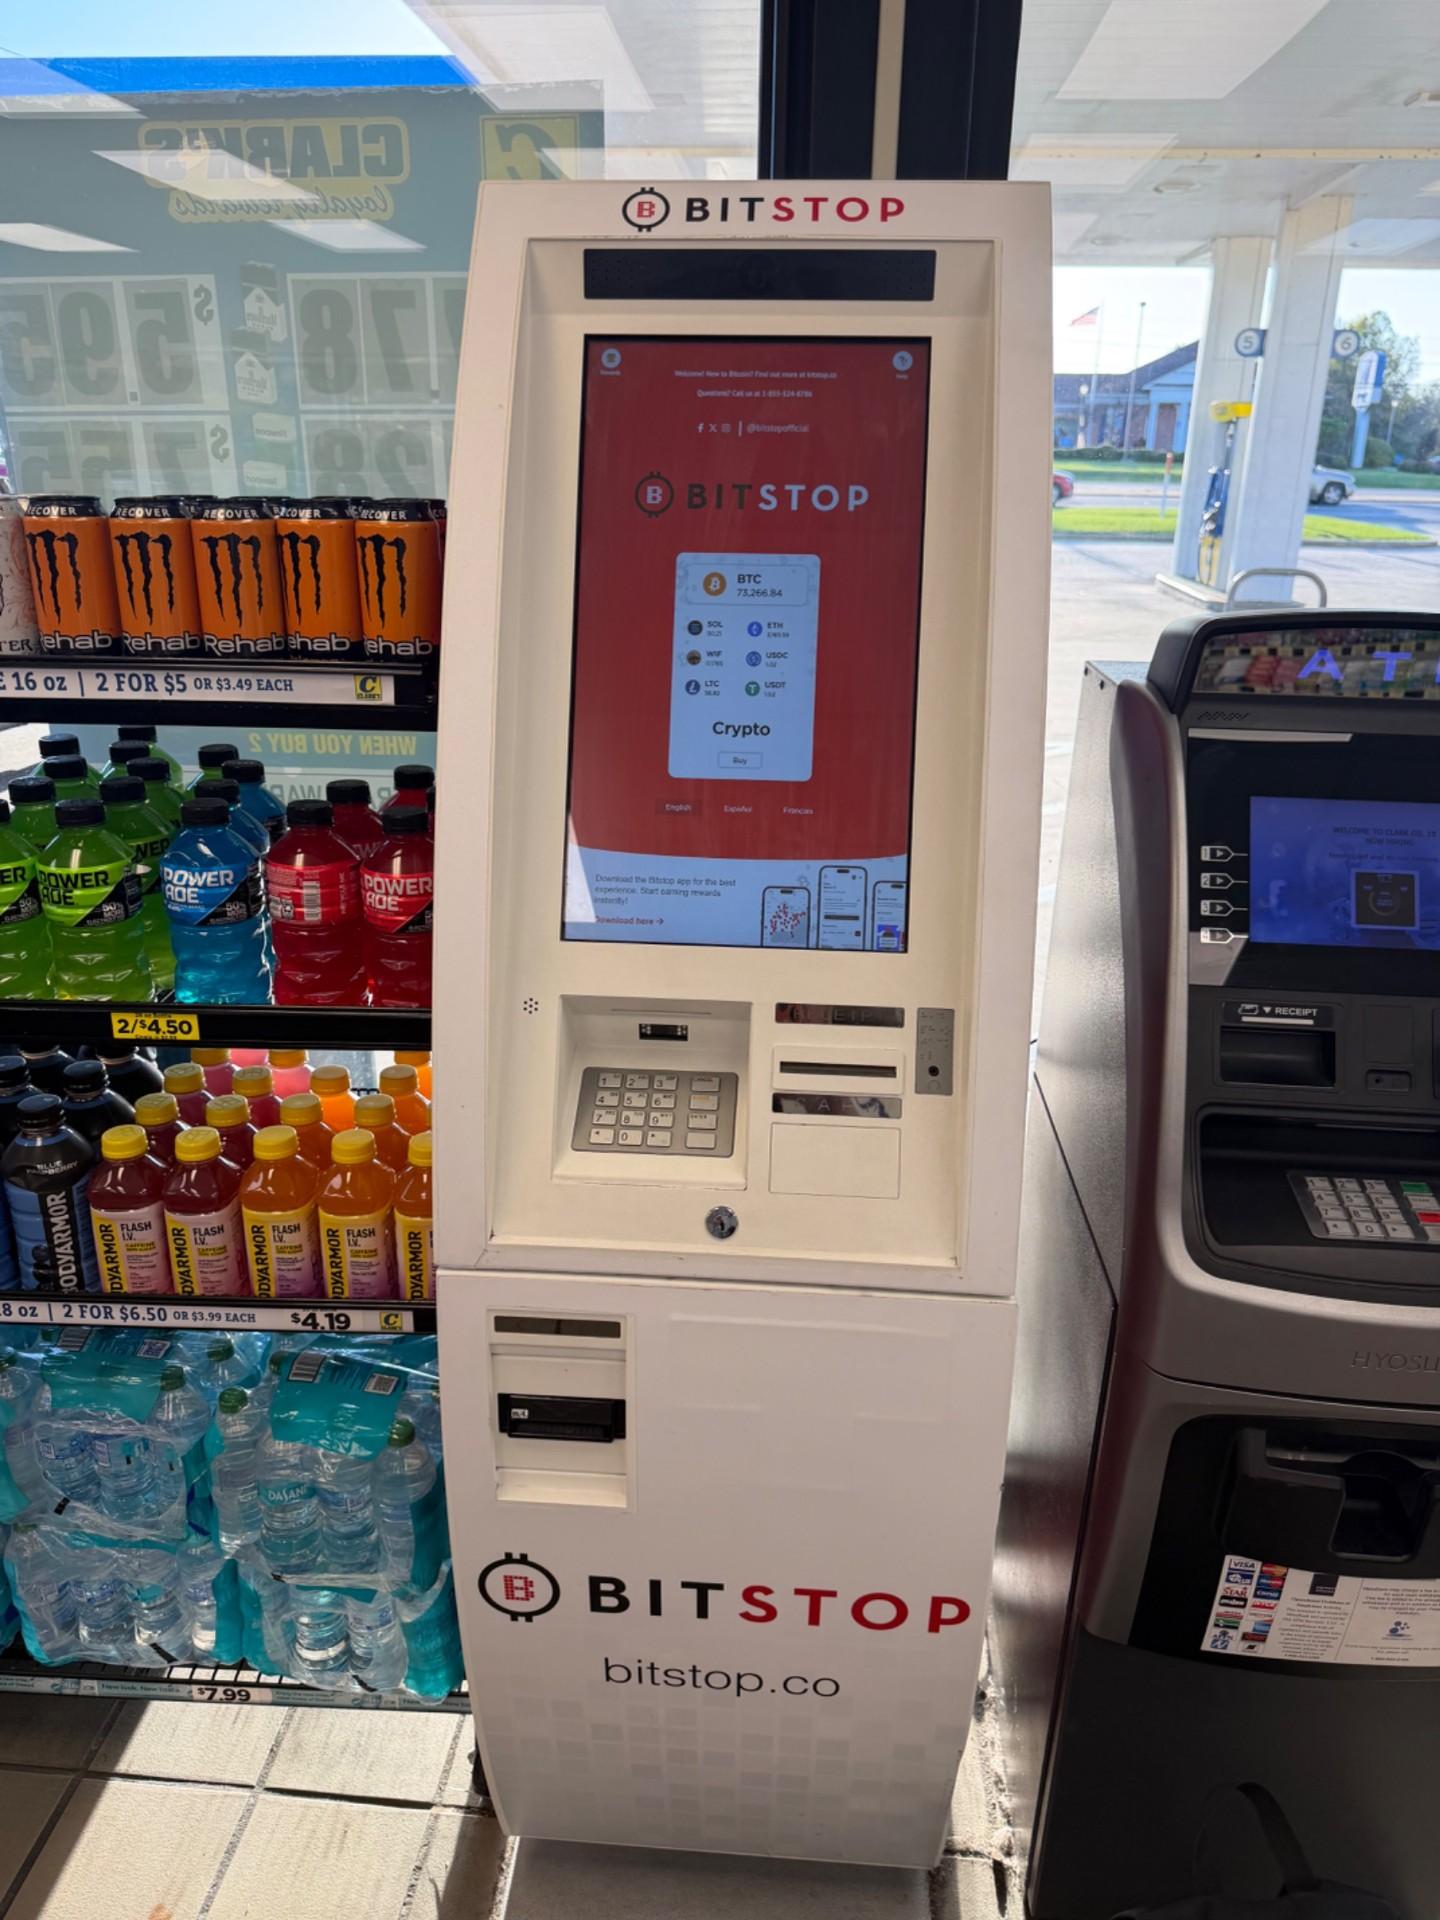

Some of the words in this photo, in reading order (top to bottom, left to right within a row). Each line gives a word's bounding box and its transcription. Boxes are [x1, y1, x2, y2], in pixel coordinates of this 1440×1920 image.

[685, 197, 905, 222] BITSTOP
[686, 483, 869, 512] BITSTOP
[115, 505, 171, 517] RECOVER
[203, 506, 260, 519] RECOVER
[737, 574, 762, 584] BTC
[40, 630, 113, 653] ehab
[122, 631, 200, 654] Rehab
[203, 632, 285, 656] Rehab
[1297, 648, 1440, 684] AT
[12, 671, 37, 691] 16
[43, 675, 68, 691] oz
[95, 673, 109, 692] 2
[114, 673, 158, 692] FOR
[164, 672, 187, 696] $5
[193, 677, 213, 690] OR
[216, 677, 252, 692] $3.49
[256, 678, 294, 692] EACH
[764, 681, 787, 689] USDT
[712, 721, 771, 738] Crypto
[733, 757, 747, 765] Buy
[665, 803, 692, 812] English
[38, 870, 110, 889] POWER
[163, 867, 234, 887] POWER
[364, 874, 433, 896] POWER
[595, 874, 634, 884] Download
[634, 875, 647, 883] the
[677, 878, 691, 886] app
[704, 878, 717, 886] the
[719, 879, 737, 887] best
[165, 884, 199, 903] ADE
[640, 887, 659, 895] Start
[366, 892, 400, 911] ADE
[1274, 1006, 1318, 1016] RECEIPT
[117, 1018, 192, 1035] 2/$4.50
[120, 1221, 152, 1233] FLASH
[192, 1224, 225, 1238] FLASH
[272, 1223, 301, 1235] FLASH
[346, 1227, 376, 1239] FLASH
[0, 1303, 12, 1317] 8
[18, 1306, 38, 1317] oz
[62, 1304, 73, 1318] 2
[78, 1304, 114, 1320] FOR
[120, 1305, 167, 1322] $6.50
[173, 1310, 188, 1321] OR
[192, 1310, 222, 1322] $3.99
[225, 1312, 256, 1323] EACH
[291, 1312, 351, 1331] $4.19
[1232, 1560, 1256, 1569] VISA
[1223, 1586, 1248, 1597] STAR
[587, 1574, 972, 1634] BITSTOP
[604, 1656, 841, 1698] bitstop.co
[197, 1687, 251, 1702] $7.99
